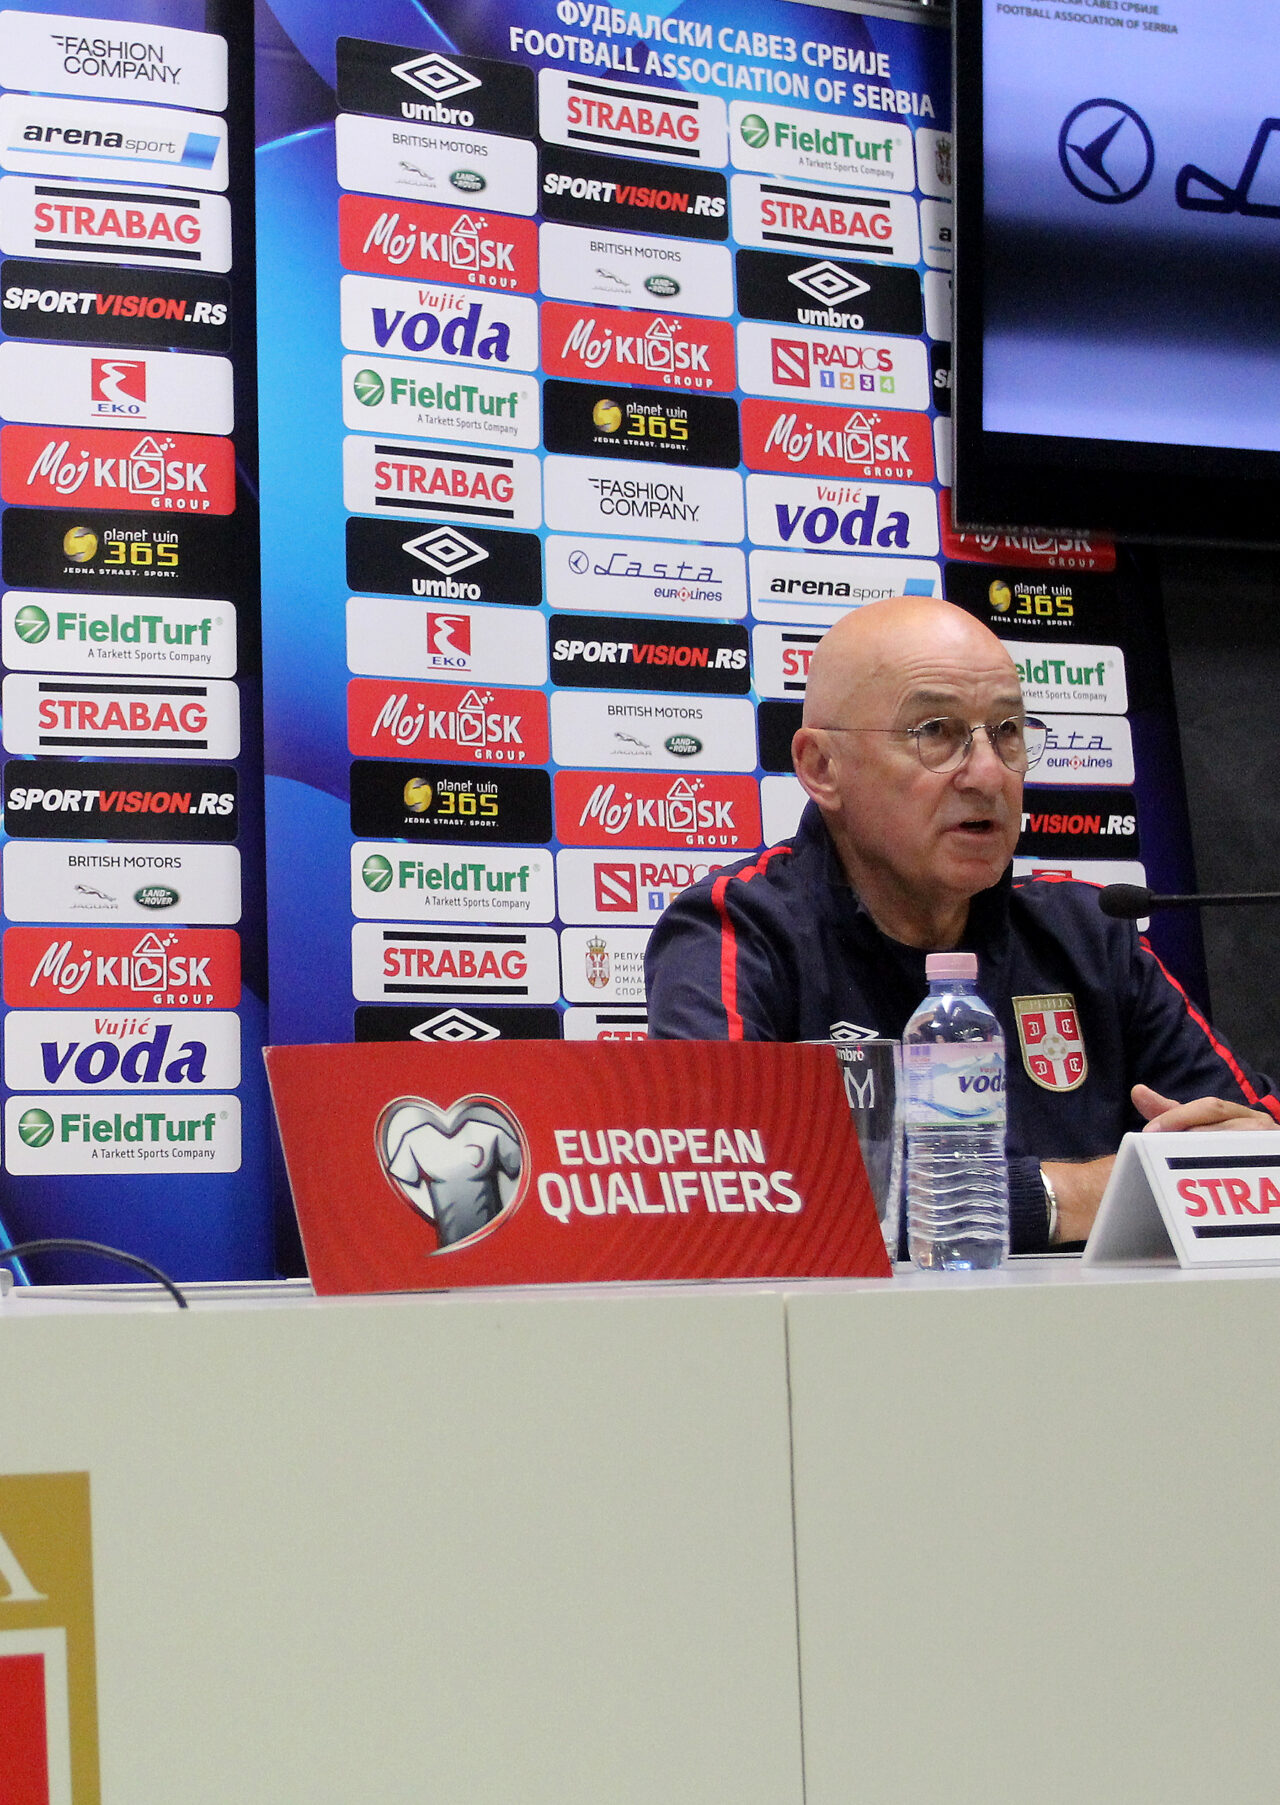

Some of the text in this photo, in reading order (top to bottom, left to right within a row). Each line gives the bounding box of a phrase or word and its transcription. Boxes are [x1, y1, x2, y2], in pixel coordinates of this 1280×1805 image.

[997, 3, 1051, 19] FOOTBALL
[1054, 11, 1123, 27] ASSOCIATION
[1126, 20, 1139, 28] OF
[1142, 22, 1178, 34] SERBIA
[556, 0, 890, 78] ФУДБАЛСКИ САВЕЗ СРБИЈЕ
[510, 27, 932, 116] FOOTBALL ASSOCIATION OF SERBIA
[401, 102, 474, 127] umbro
[567, 97, 699, 142] STRABAG
[393, 133, 488, 156] BRITISH MOTORS
[775, 125, 892, 163] FieldTurf
[34, 203, 200, 244] STRABAG
[3, 287, 227, 325] SPORTVISION.RS
[419, 290, 465, 312] Vujić
[372, 300, 510, 363] voda
[796, 308, 864, 330] umbro
[562, 319, 612, 366] Moj
[663, 375, 712, 388] GROUP
[98, 404, 140, 414] EKO
[391, 378, 518, 421] FieldTurf
[764, 414, 813, 461] Moj
[27, 441, 89, 494] Moj
[864, 466, 913, 478] GROUP
[375, 461, 513, 502] STRABAG
[601, 480, 683, 502] FASHION
[151, 497, 209, 510] GROUP
[104, 528, 178, 544] planet win
[104, 542, 178, 566] 365
[1048, 557, 1094, 567] GROUP
[594, 553, 722, 583] Lasta
[412, 577, 481, 602] umbro
[1015, 583, 1072, 596] planet win
[1017, 594, 1073, 616] 365
[57, 612, 211, 645] FieldTurf
[430, 657, 468, 669] EKO
[553, 640, 746, 669] SPORTVISION.RS
[1018, 659, 1105, 686] eldTurf
[608, 705, 702, 719] BRITISH MOTORS
[1045, 733, 1112, 750] sta
[437, 779, 497, 794] planet win
[8, 788, 234, 815] SPORTVISION.RS
[438, 792, 498, 816] 365
[579, 784, 632, 834] Moj
[1020, 813, 1135, 835] TVISION.RS
[686, 835, 738, 845] GROUP
[69, 856, 181, 868] BRITISH MOTORS
[399, 861, 529, 892] FieldTurf
[425, 896, 530, 910] A Tarkett Sports Company
[30, 941, 92, 994] Moj
[383, 947, 527, 979] STRABAG
[153, 994, 213, 1004] GROUP
[95, 1018, 151, 1039] Vujić
[41, 1023, 207, 1084] voda
[837, 1047, 864, 1061] mbro
[958, 1067, 1006, 1095] vod
[61, 1113, 215, 1142] FieldTurf
[92, 1148, 215, 1160] A Tarkett Sports Company
[554, 1128, 765, 1165] EUROPEAN
[538, 1171, 801, 1223] QUALIFIERS
[1177, 1177, 1280, 1217] STRA
